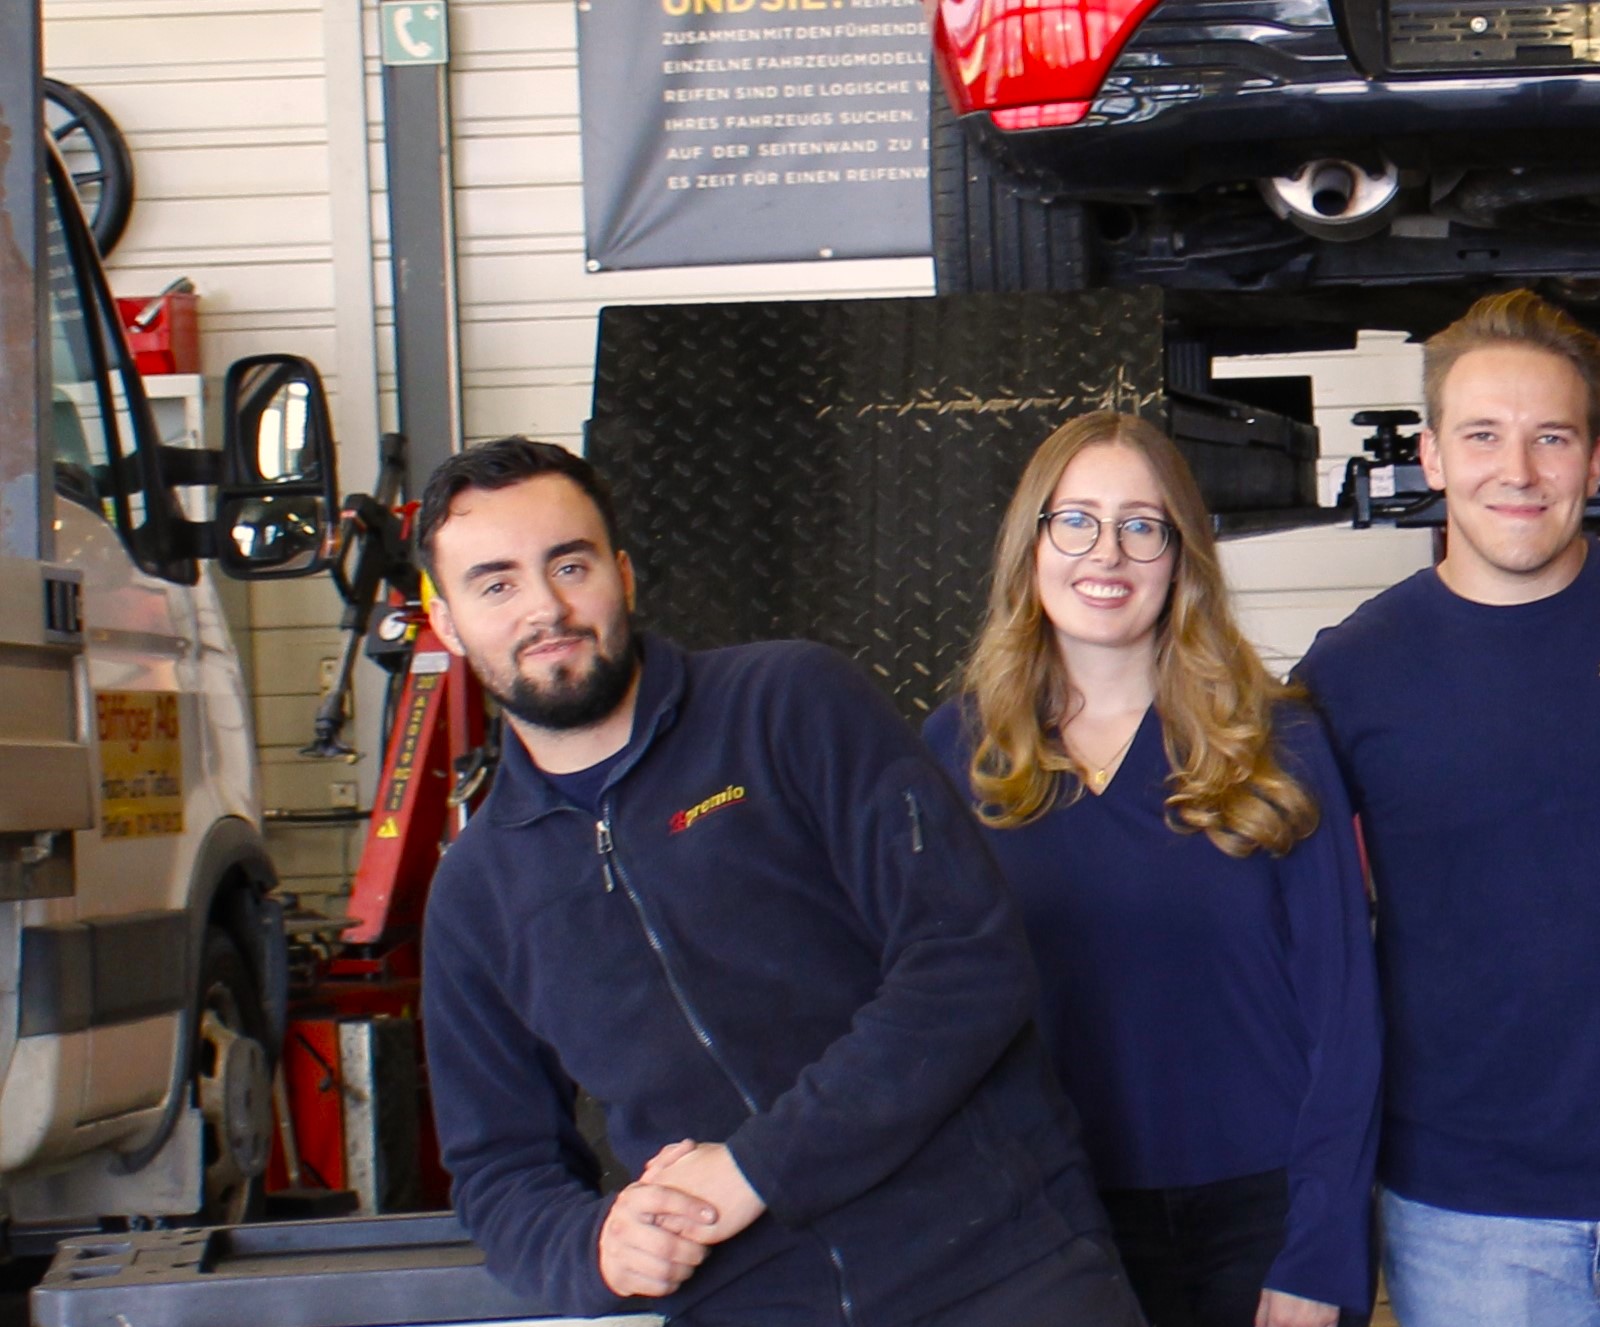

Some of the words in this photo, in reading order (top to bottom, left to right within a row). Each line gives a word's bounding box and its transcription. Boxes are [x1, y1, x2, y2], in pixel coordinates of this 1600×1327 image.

[662, 29, 760, 46] ZUSAMMEN
[761, 27, 793, 41] MIT
[795, 25, 832, 40] DEN
[834, 21, 929, 38] FÜHRENDE
[662, 58, 752, 74] EINZELNE
[756, 51, 927, 70] FAHRZEUGMODELL
[664, 87, 730, 103] REIFEN
[735, 85, 779, 100] SIND
[783, 84, 814, 98] DIE
[819, 81, 910, 97] LOGISCHE
[664, 116, 719, 132] IHRES
[725, 112, 834, 130] FAHRZEUGS
[838, 109, 918, 125] SUCHEN.
[666, 146, 703, 161] AUF
[711, 144, 751, 159] DER
[757, 139, 879, 157] SEITENWAND
[887, 138, 912, 152] ZU
[666, 175, 692, 190] ES
[696, 173, 737, 189] ZEIT
[742, 169, 779, 186] FÜR
[784, 169, 841, 185] EINEN
[846, 166, 929, 182] REIFENW
